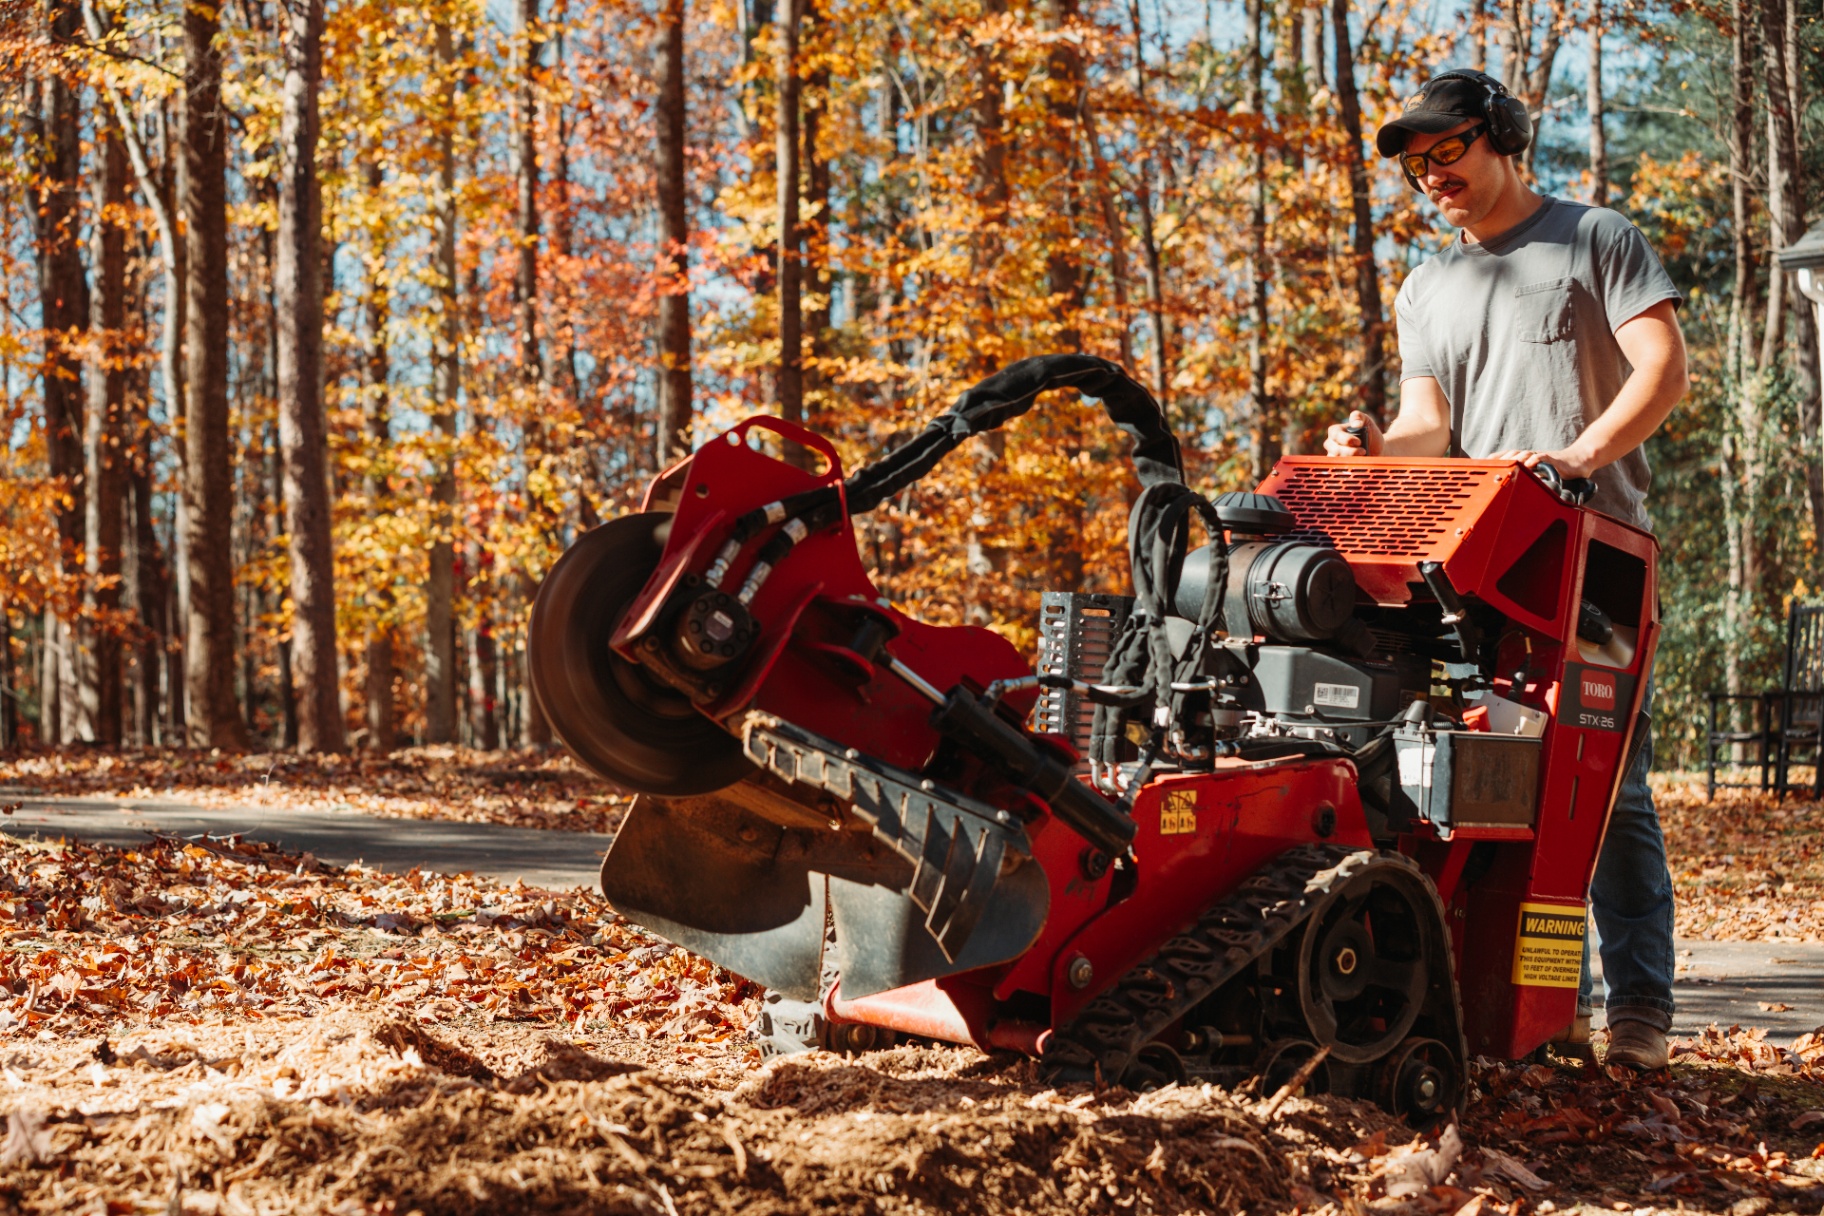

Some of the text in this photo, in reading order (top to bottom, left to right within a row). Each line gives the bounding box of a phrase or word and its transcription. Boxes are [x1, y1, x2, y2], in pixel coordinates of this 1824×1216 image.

[1583, 681, 1613, 699] TORO
[1579, 713, 1615, 728] STX-26
[1525, 917, 1585, 936] WARNING
[1522, 947, 1551, 955] UNLAWFUL
[1534, 956, 1564, 964] EQUIPMENT
